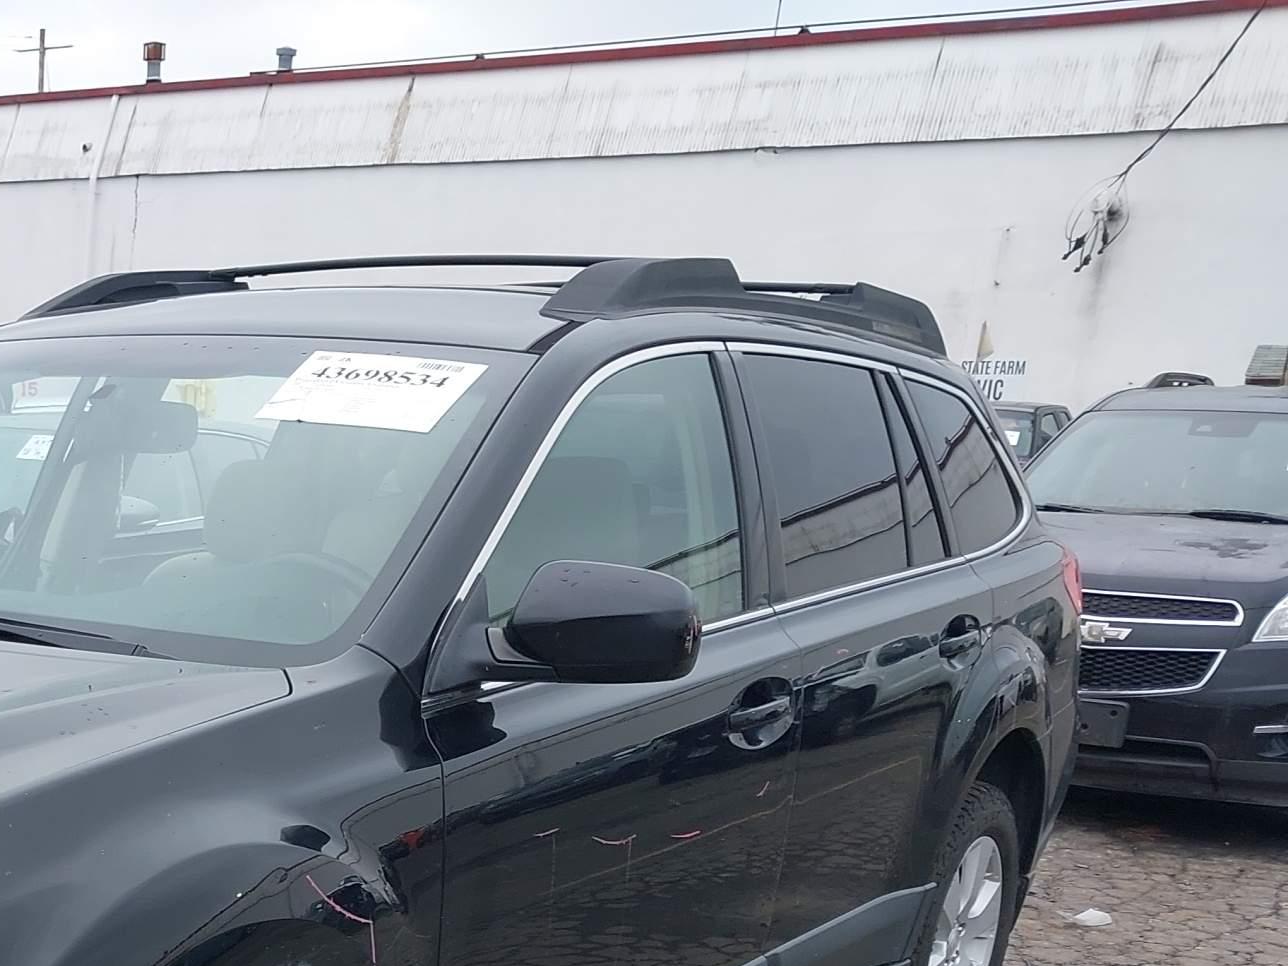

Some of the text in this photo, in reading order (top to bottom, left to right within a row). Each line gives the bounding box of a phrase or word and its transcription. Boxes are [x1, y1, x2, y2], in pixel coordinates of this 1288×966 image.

[961, 360, 1026, 375] STATE FARM
[311, 366, 450, 388] 43698534
